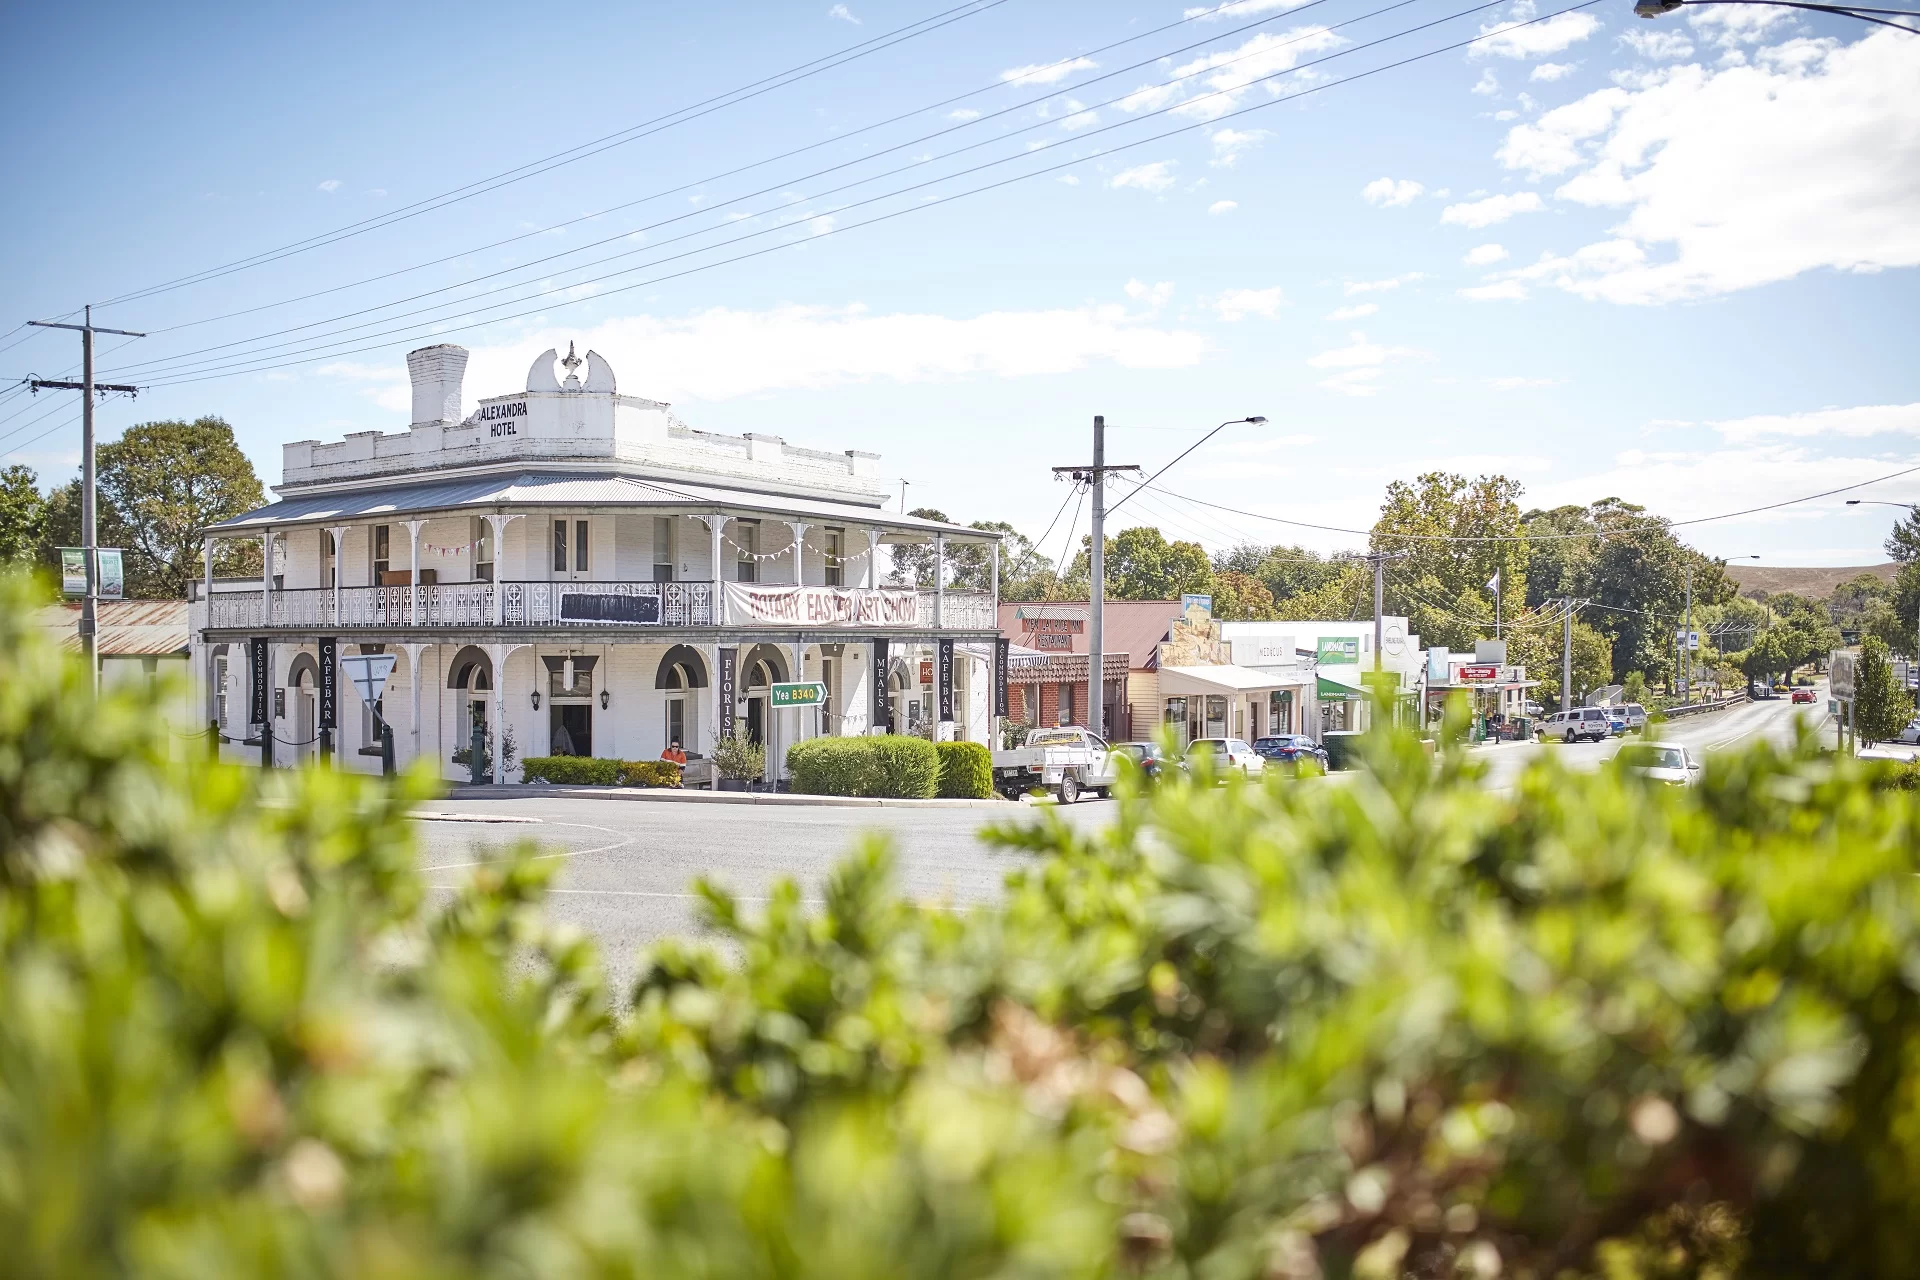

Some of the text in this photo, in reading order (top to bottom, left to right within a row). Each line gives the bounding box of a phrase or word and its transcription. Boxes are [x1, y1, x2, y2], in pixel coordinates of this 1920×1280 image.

[480, 402, 527, 421] ALEXANDRA
[490, 421, 517, 437] HOTEL
[749, 591, 917, 622] ROTARY EASTER ART SHOW
[1321, 641, 1345, 652] LANDMARK
[256, 643, 264, 721] ACCOMMODATION
[323, 645, 332, 720] CAFE-BAR
[723, 659, 732, 738] FLORIST
[775, 688, 814, 701] Yea B340
[877, 658, 886, 707] MEALS
[942, 644, 950, 714] CAFE-BAR
